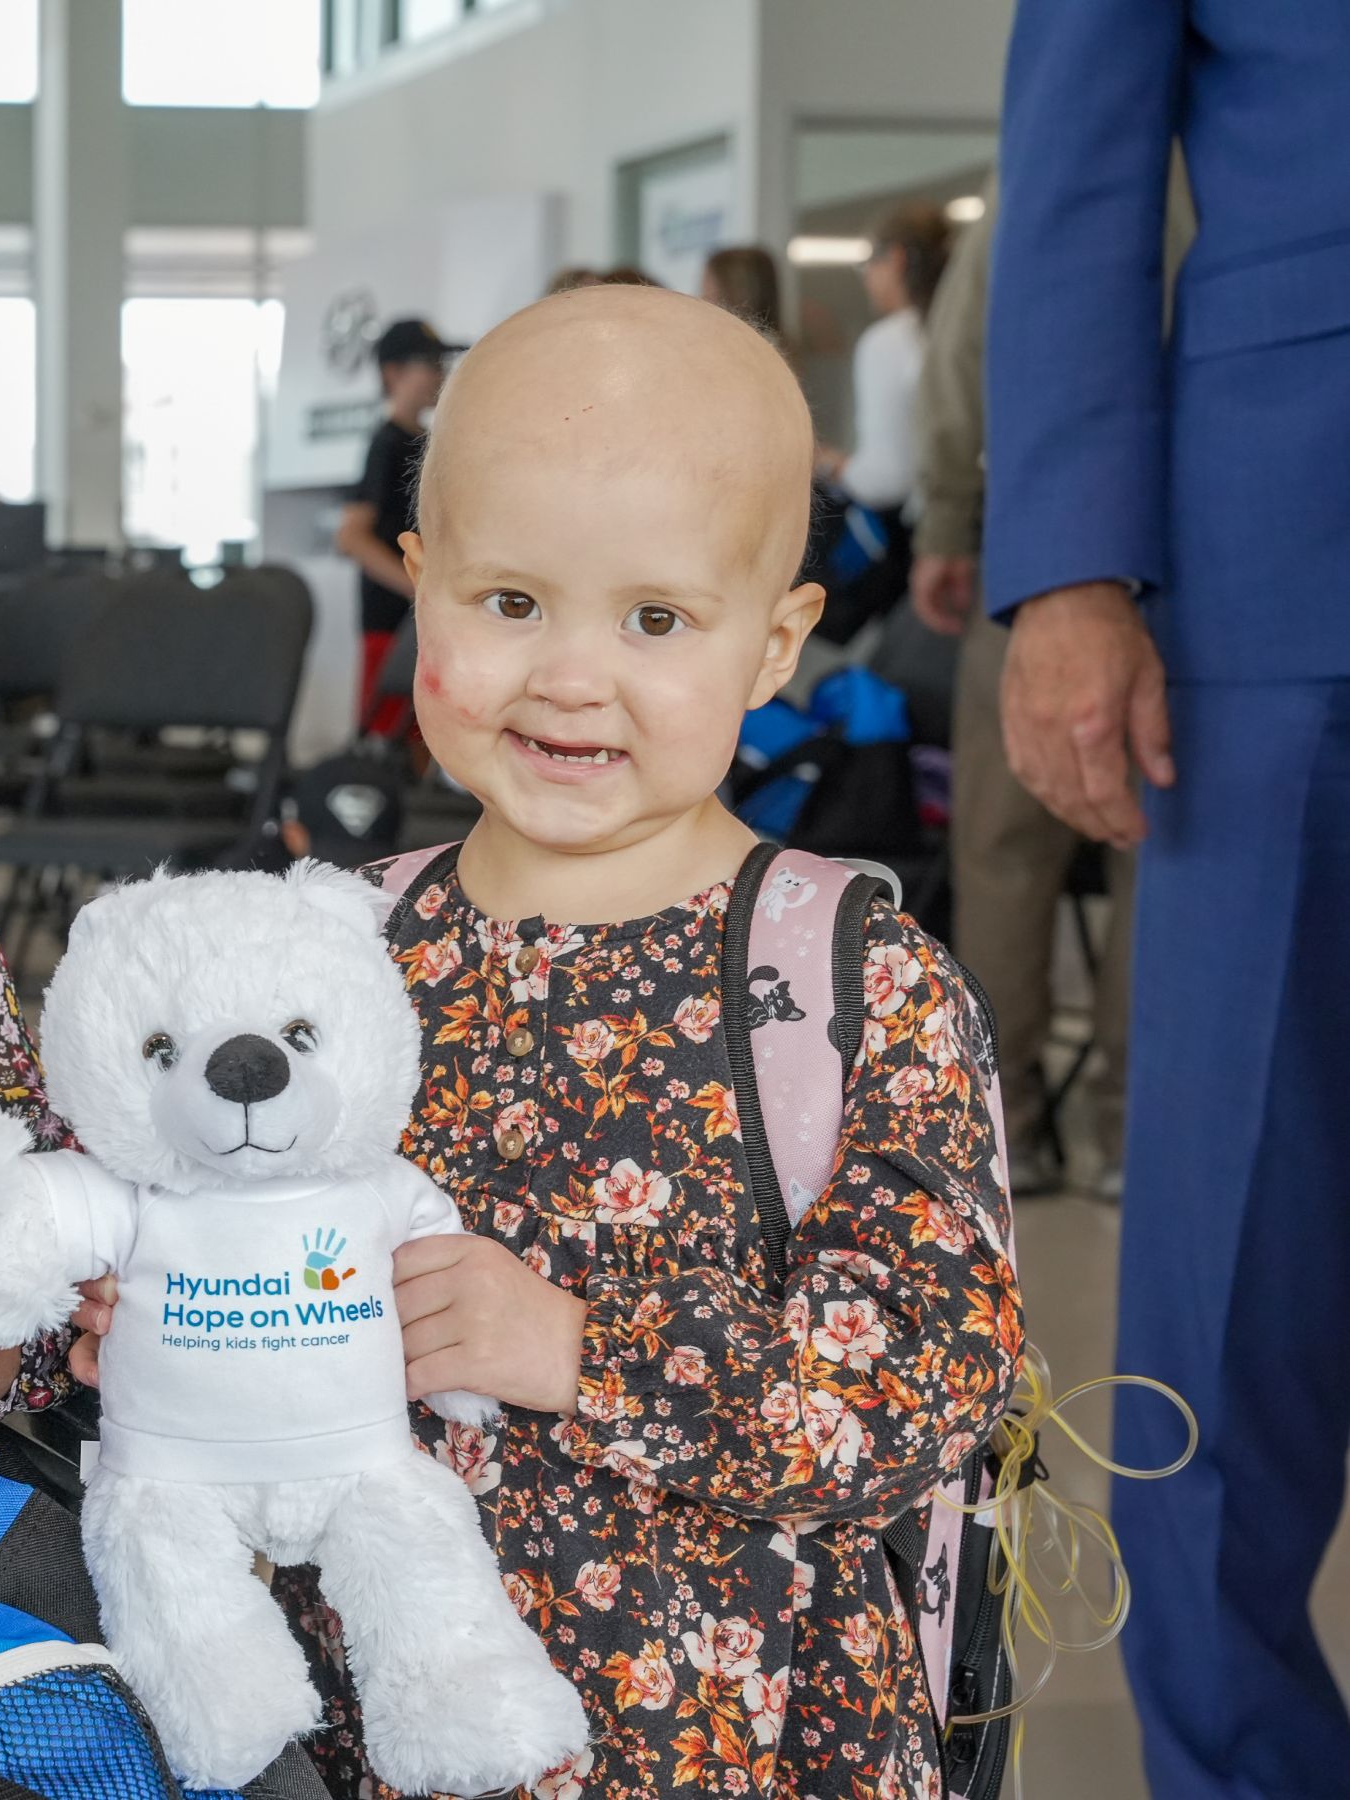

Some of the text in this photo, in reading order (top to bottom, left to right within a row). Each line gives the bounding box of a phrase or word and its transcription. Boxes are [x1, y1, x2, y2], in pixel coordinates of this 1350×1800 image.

[166, 1272, 290, 1300] Hyundai
[163, 1296, 383, 1332] Hope on Wheels
[162, 1334, 350, 1351] Helping kids fight cancer
